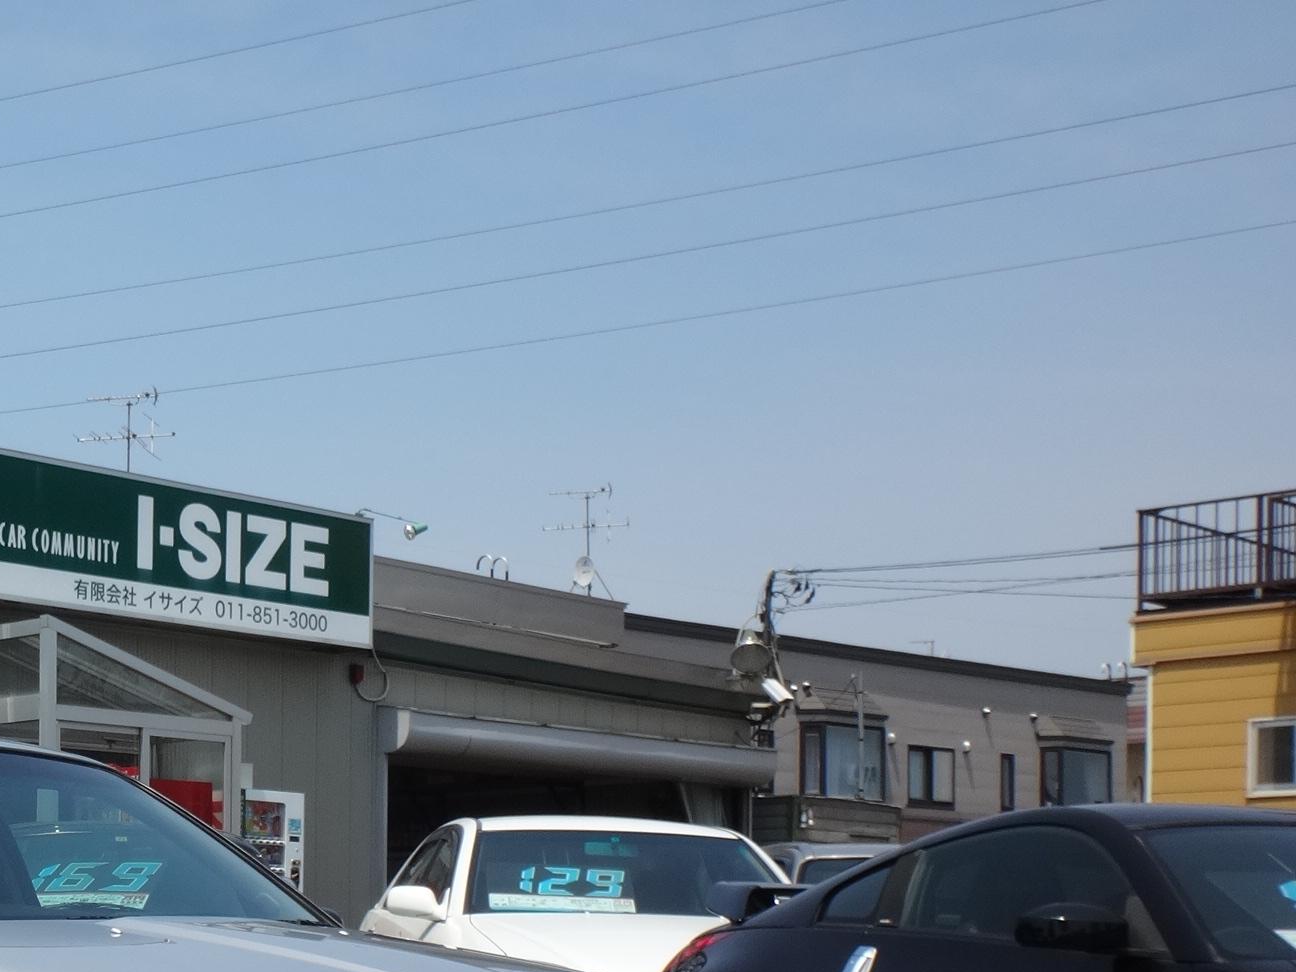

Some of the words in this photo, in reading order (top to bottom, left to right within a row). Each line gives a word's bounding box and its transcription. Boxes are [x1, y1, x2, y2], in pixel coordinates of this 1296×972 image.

[31, 527, 120, 565] COMMUNITY
[74, 579, 137, 607] 有限会社
[143, 591, 204, 616] イサイズ
[215, 600, 328, 632] 011-851-3000
[519, 866, 625, 897] 129
